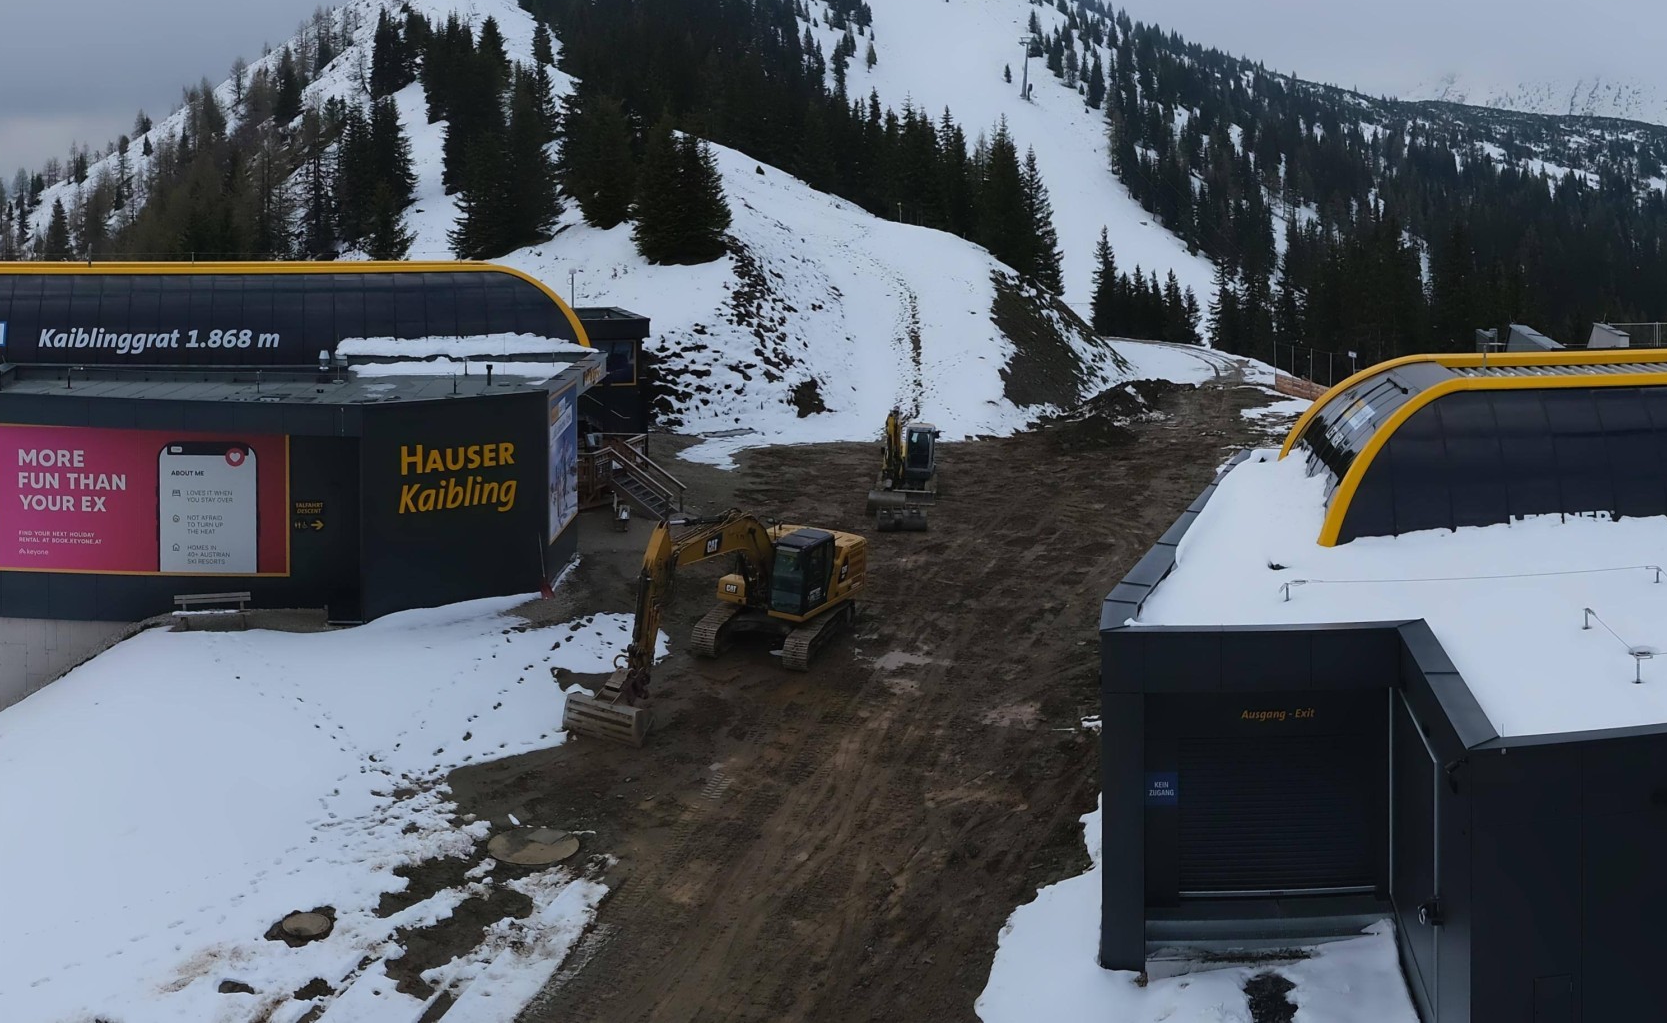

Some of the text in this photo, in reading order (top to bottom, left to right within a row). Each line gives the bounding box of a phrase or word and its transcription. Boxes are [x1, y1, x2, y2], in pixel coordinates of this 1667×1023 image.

[38, 327, 280, 355] Kaiblinggrat 1.868 m
[18, 448, 85, 468] MORE
[400, 442, 516, 476] HAUSER
[18, 472, 127, 491] FUN THAN
[19, 494, 107, 512] YOUR EX
[398, 476, 518, 514] Kaibling
[1509, 510, 1613, 526] LNER
[26, 548, 49, 556] keyone
[706, 538, 719, 554] CAT
[725, 584, 738, 593] CAT
[1241, 709, 1286, 722] Ausgang
[1294, 707, 1315, 718] Exit
[1149, 789, 1175, 797] ZUGANG
[1154, 781, 1169, 789] KEIN
